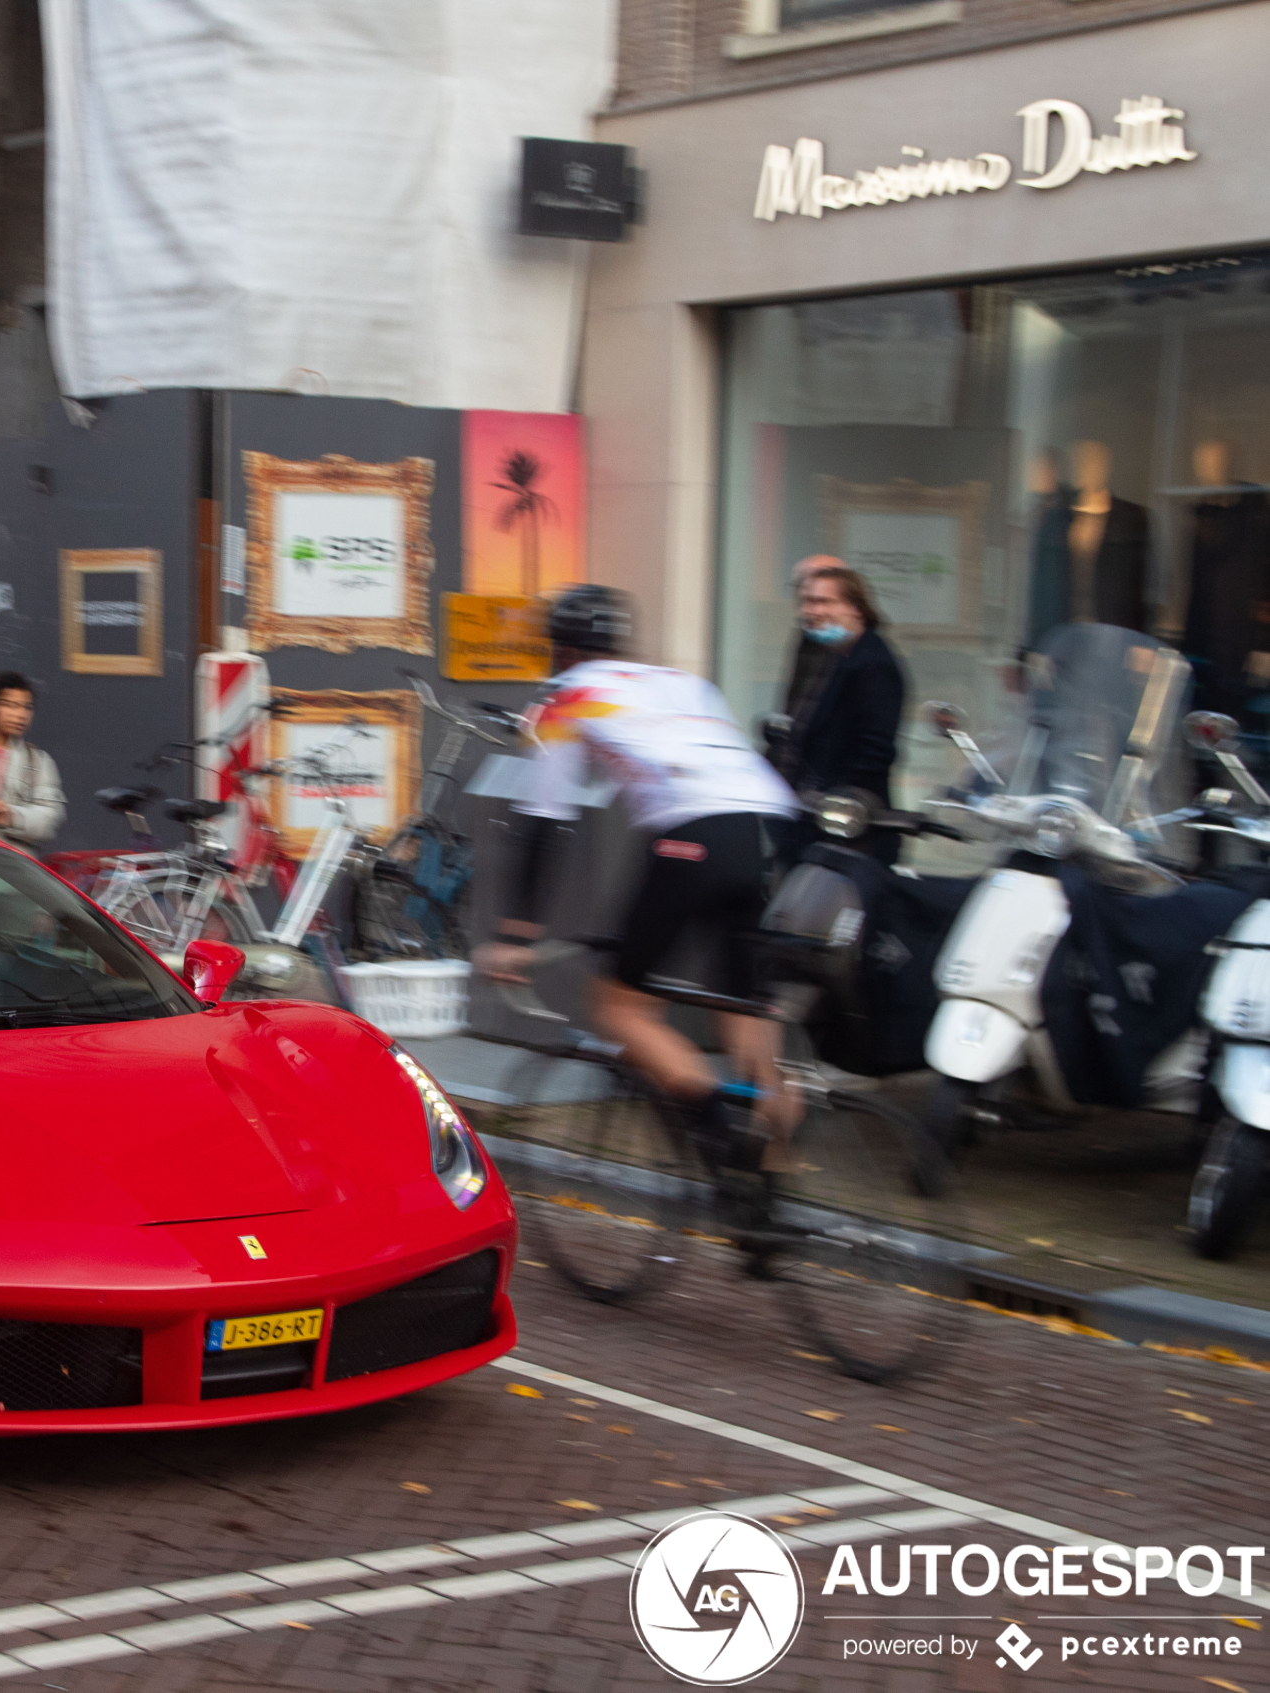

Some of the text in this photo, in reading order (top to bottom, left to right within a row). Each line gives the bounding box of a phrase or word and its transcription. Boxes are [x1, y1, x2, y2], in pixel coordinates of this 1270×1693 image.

[753, 94, 1199, 222] Massimo Dutti
[225, 1315, 320, 1345] J-386-RT
